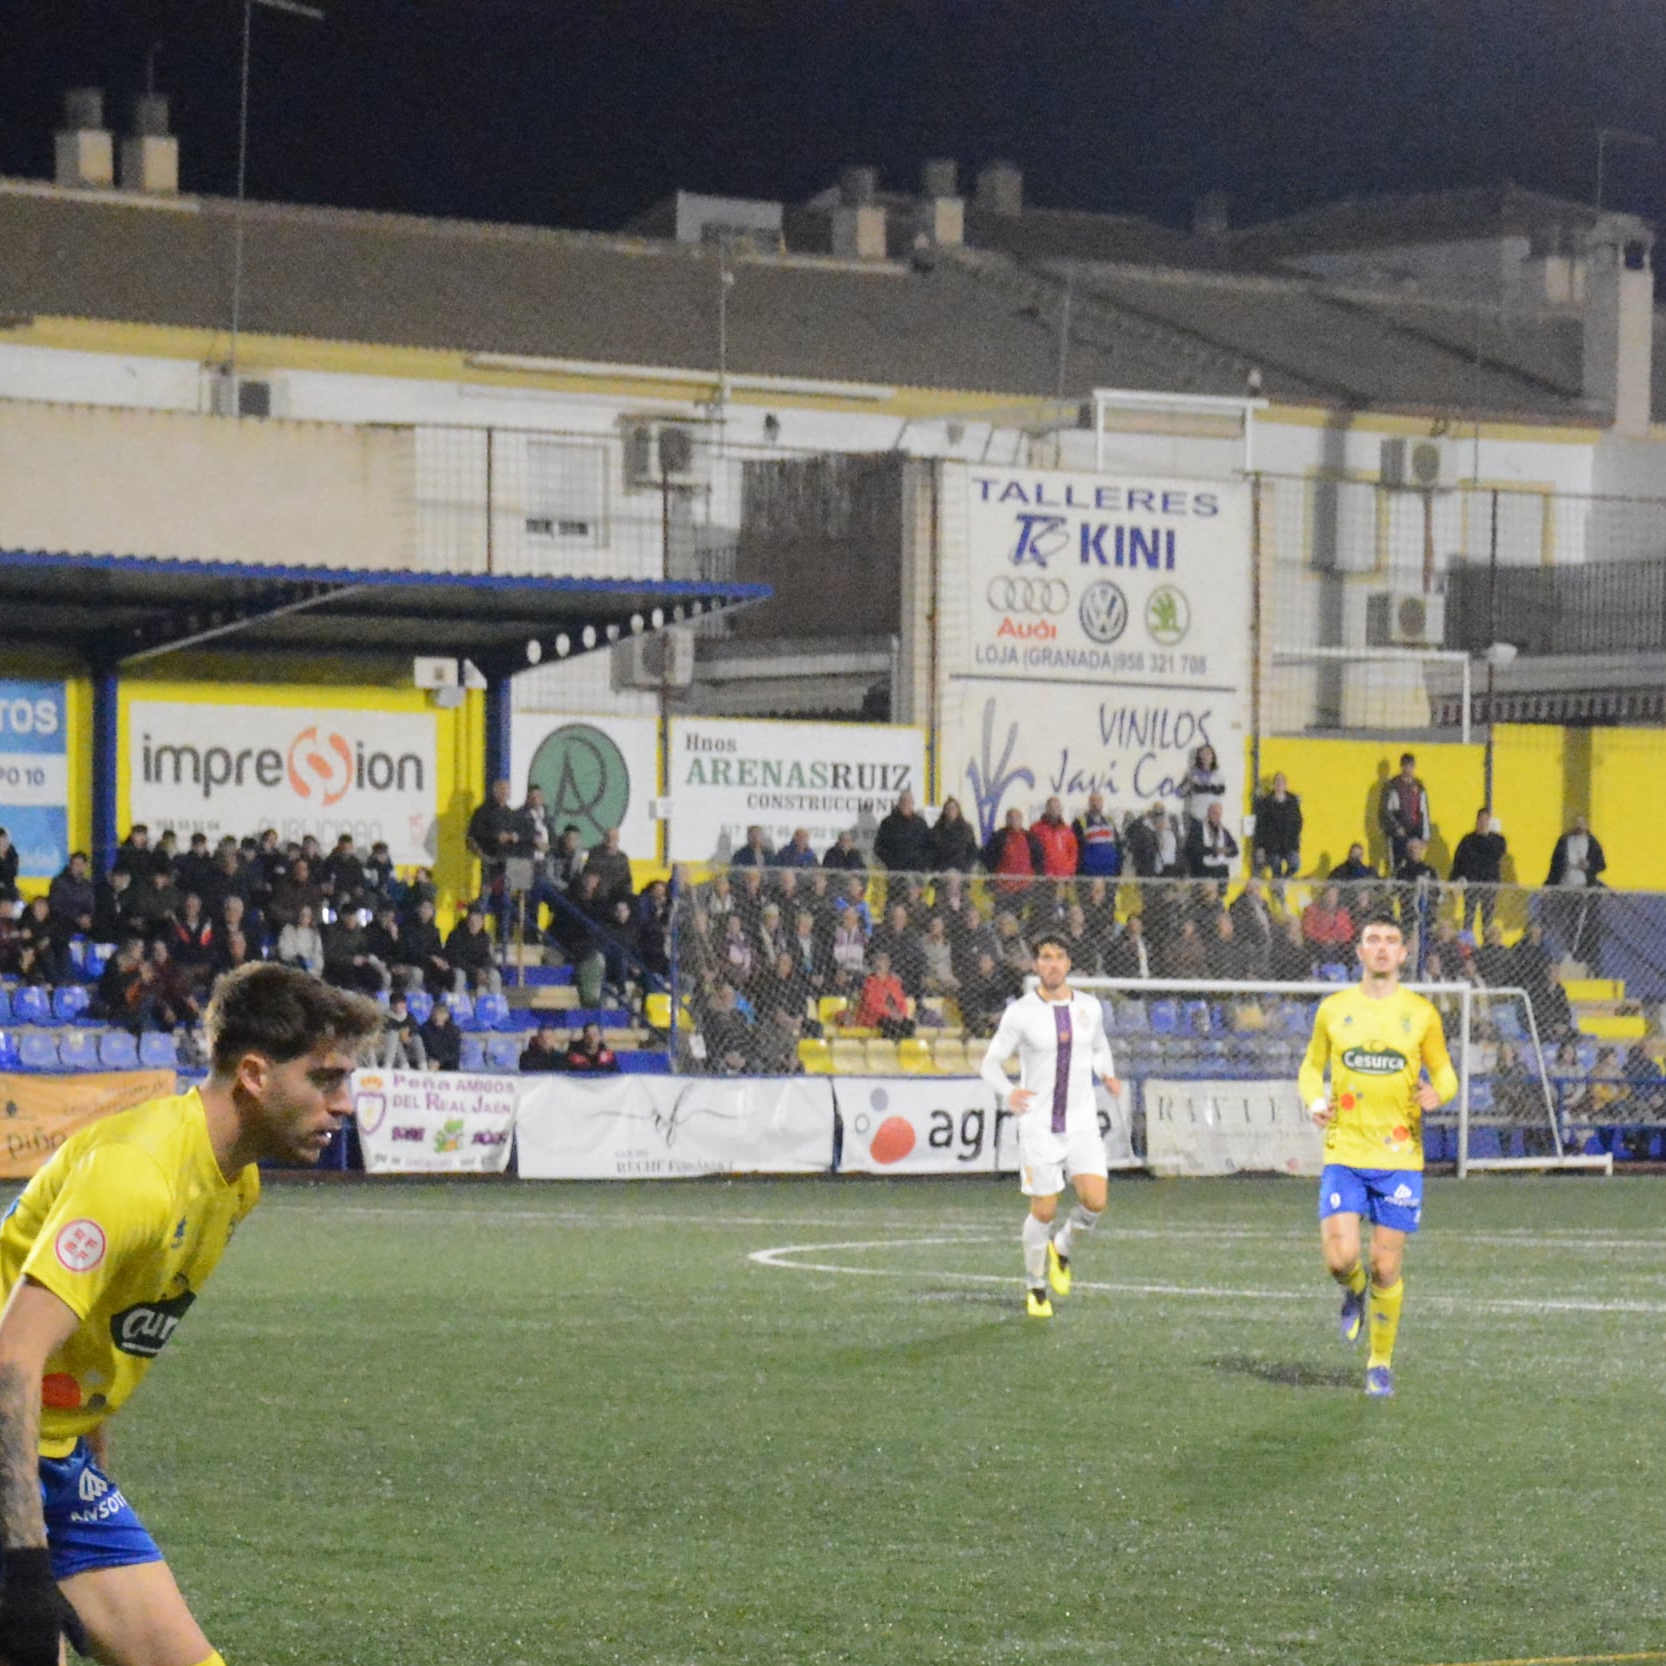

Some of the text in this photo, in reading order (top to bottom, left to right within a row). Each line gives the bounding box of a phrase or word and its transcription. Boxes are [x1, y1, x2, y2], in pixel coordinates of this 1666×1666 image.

[972, 476, 1219, 517] TALLERES
[1080, 522, 1176, 571] KINI
[976, 645, 1019, 665] LOJA
[1099, 703, 1212, 749] VINILOS
[685, 733, 738, 753] Hnos
[26, 767, 46, 787] 10
[1050, 748, 1118, 796] Javi
[1343, 1050, 1406, 1070] Cesurca
[456, 1079, 515, 1094] AMIGOS
[392, 1095, 420, 1110] DEL
